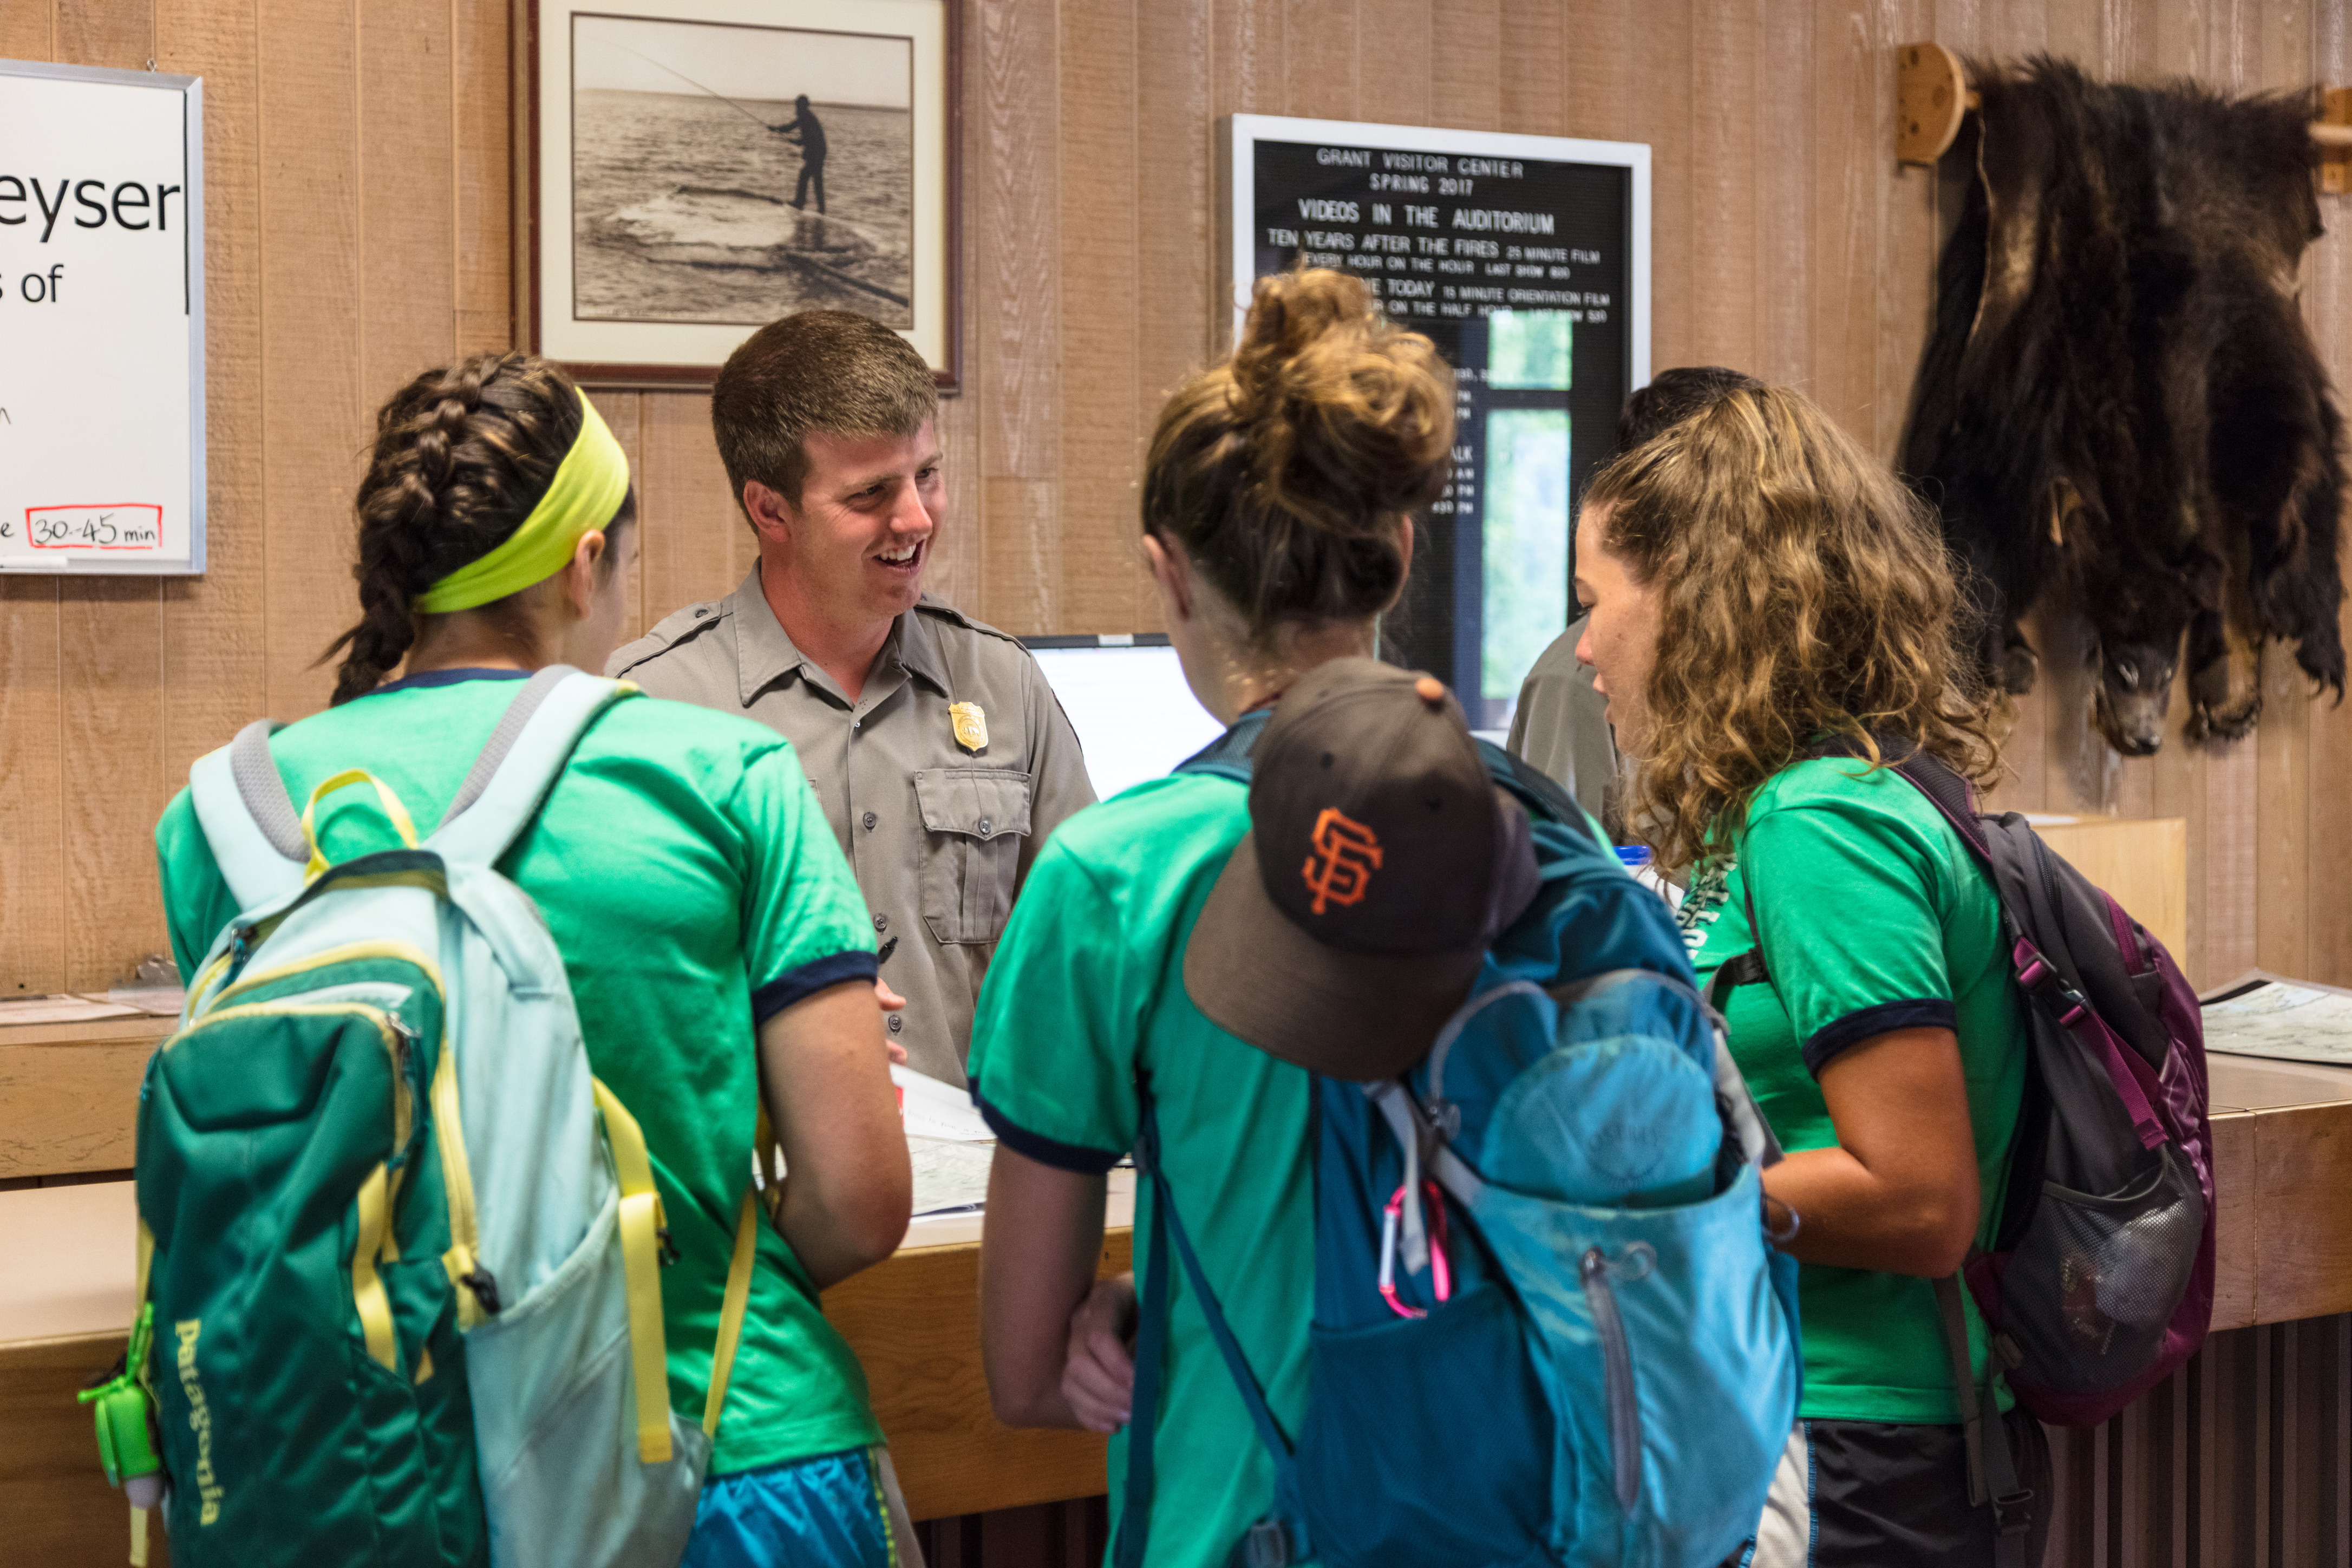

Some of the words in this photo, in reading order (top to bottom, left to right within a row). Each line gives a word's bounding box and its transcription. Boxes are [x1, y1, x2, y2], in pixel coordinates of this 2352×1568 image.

[1316, 148, 1371, 168] GRANT
[1383, 153, 1448, 173] VISITOR
[1457, 158, 1524, 179] CENTER
[1369, 173, 1429, 194] SPRING
[1438, 177, 1474, 197] 2017
[1298, 198, 1360, 223] VIDEOS
[1372, 203, 1392, 225] IN
[1403, 205, 1439, 228] THE
[1452, 208, 1554, 236] AUDITORIUM
[1268, 228, 1299, 247] TEN
[1304, 230, 1355, 251] YEARS
[1361, 234, 1410, 253] AFTER
[1417, 237, 1449, 256] THE
[1454, 238, 1499, 259] FIRES
[1505, 245, 1523, 261] 25
[1524, 246, 1568, 264] MINUTE
[1571, 249, 1600, 265] FILM
[1304, 252, 1343, 267] EVERY
[1347, 254, 1383, 270] HOUR
[1386, 256, 1407, 271] ON
[1410, 257, 1434, 272] THE
[1438, 259, 1474, 275] HOUR
[1485, 262, 1511, 277] LAST
[1514, 264, 1544, 279] SHOW
[21, 263, 64, 303] of
[1387, 278, 1435, 298] TODAY
[1442, 285, 1456, 300] 15
[1459, 286, 1505, 303] MINUTE
[1507, 288, 1581, 306] ORIENTATION
[1583, 291, 1610, 308] FILM
[1387, 299, 1408, 315] ON
[1413, 300, 1436, 316] THE
[1440, 302, 1472, 318] HALF
[124, 526, 155, 541] min
